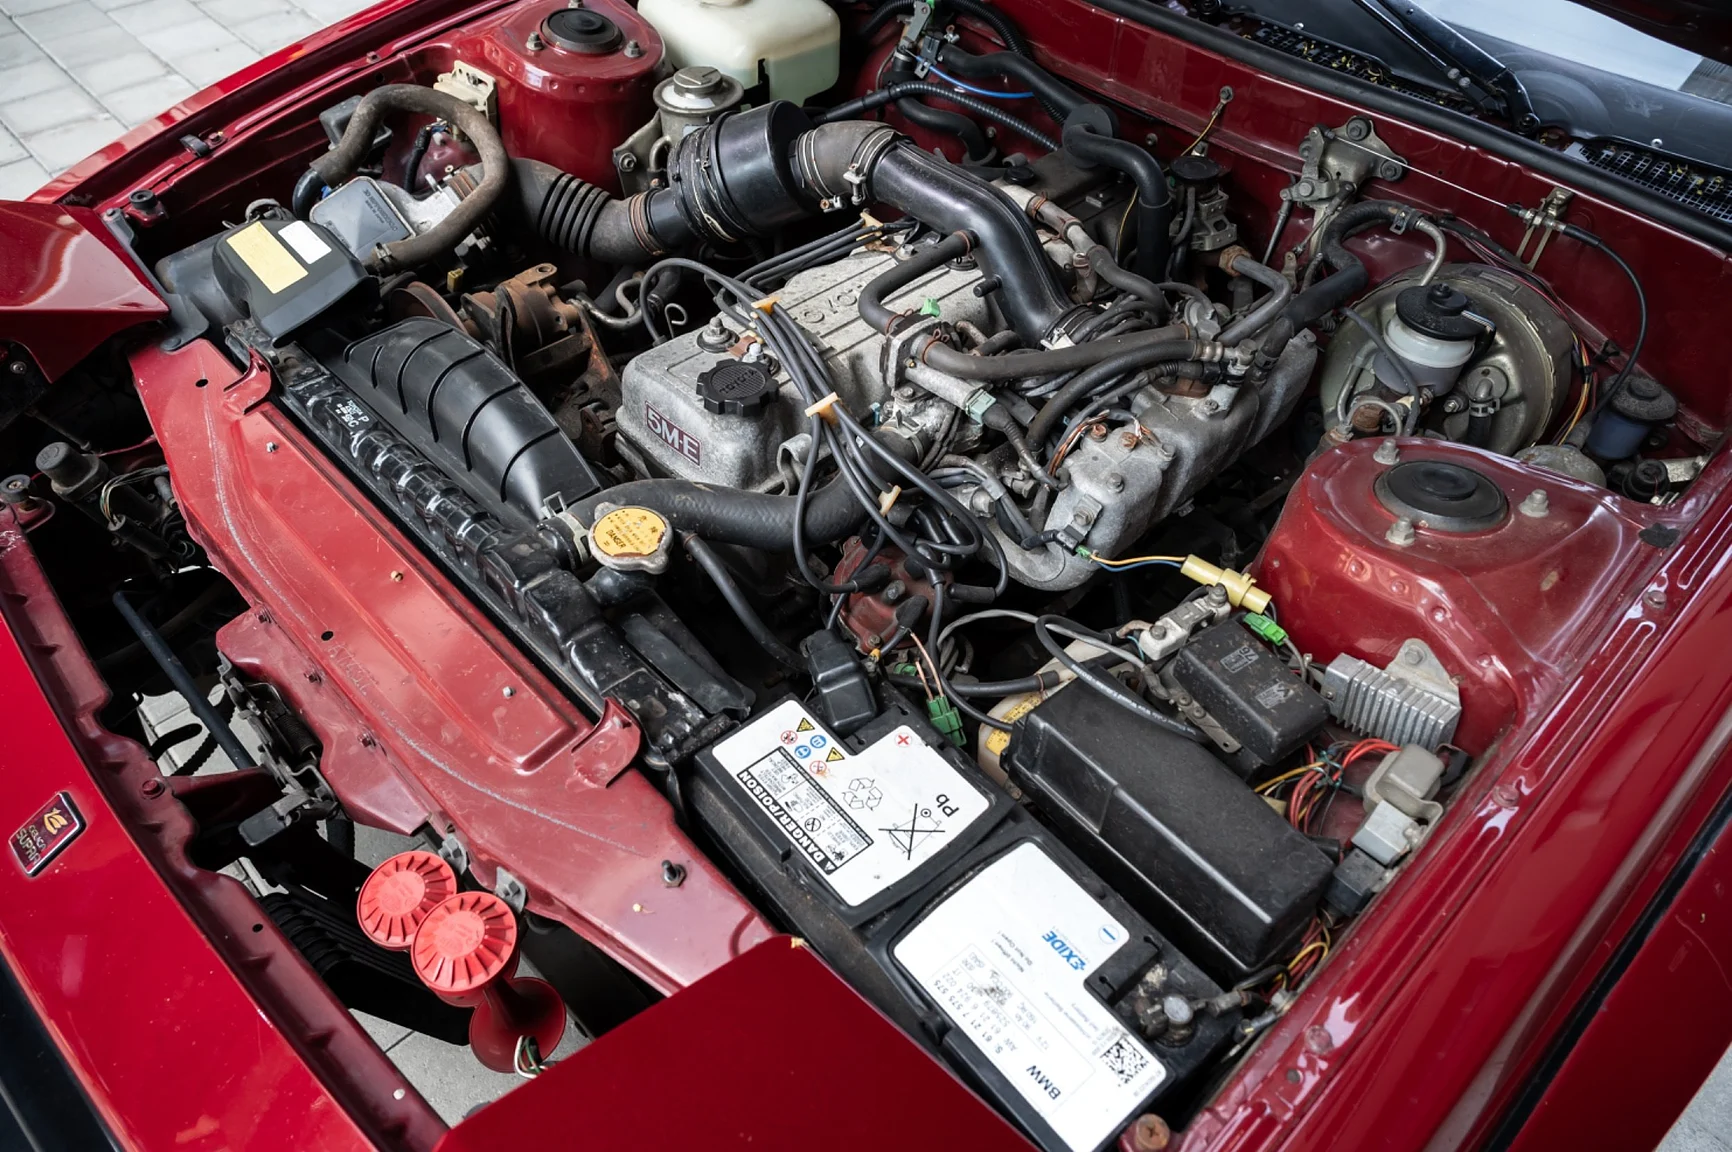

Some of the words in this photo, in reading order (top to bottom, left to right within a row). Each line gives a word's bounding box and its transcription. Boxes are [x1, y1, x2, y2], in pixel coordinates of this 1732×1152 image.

[719, 369, 757, 393] TOYOTA
[739, 770, 825, 862] DANGER/POISON
[937, 794, 959, 817] Pb
[16, 828, 41, 865] SUPRA
[28, 825, 47, 851] CELICA
[1041, 930, 1086, 972] EXIDE
[932, 978, 949, 995] 575
[947, 994, 964, 1011] 575
[970, 1018, 982, 1030] 21
[1026, 1064, 1062, 1100] BMW
